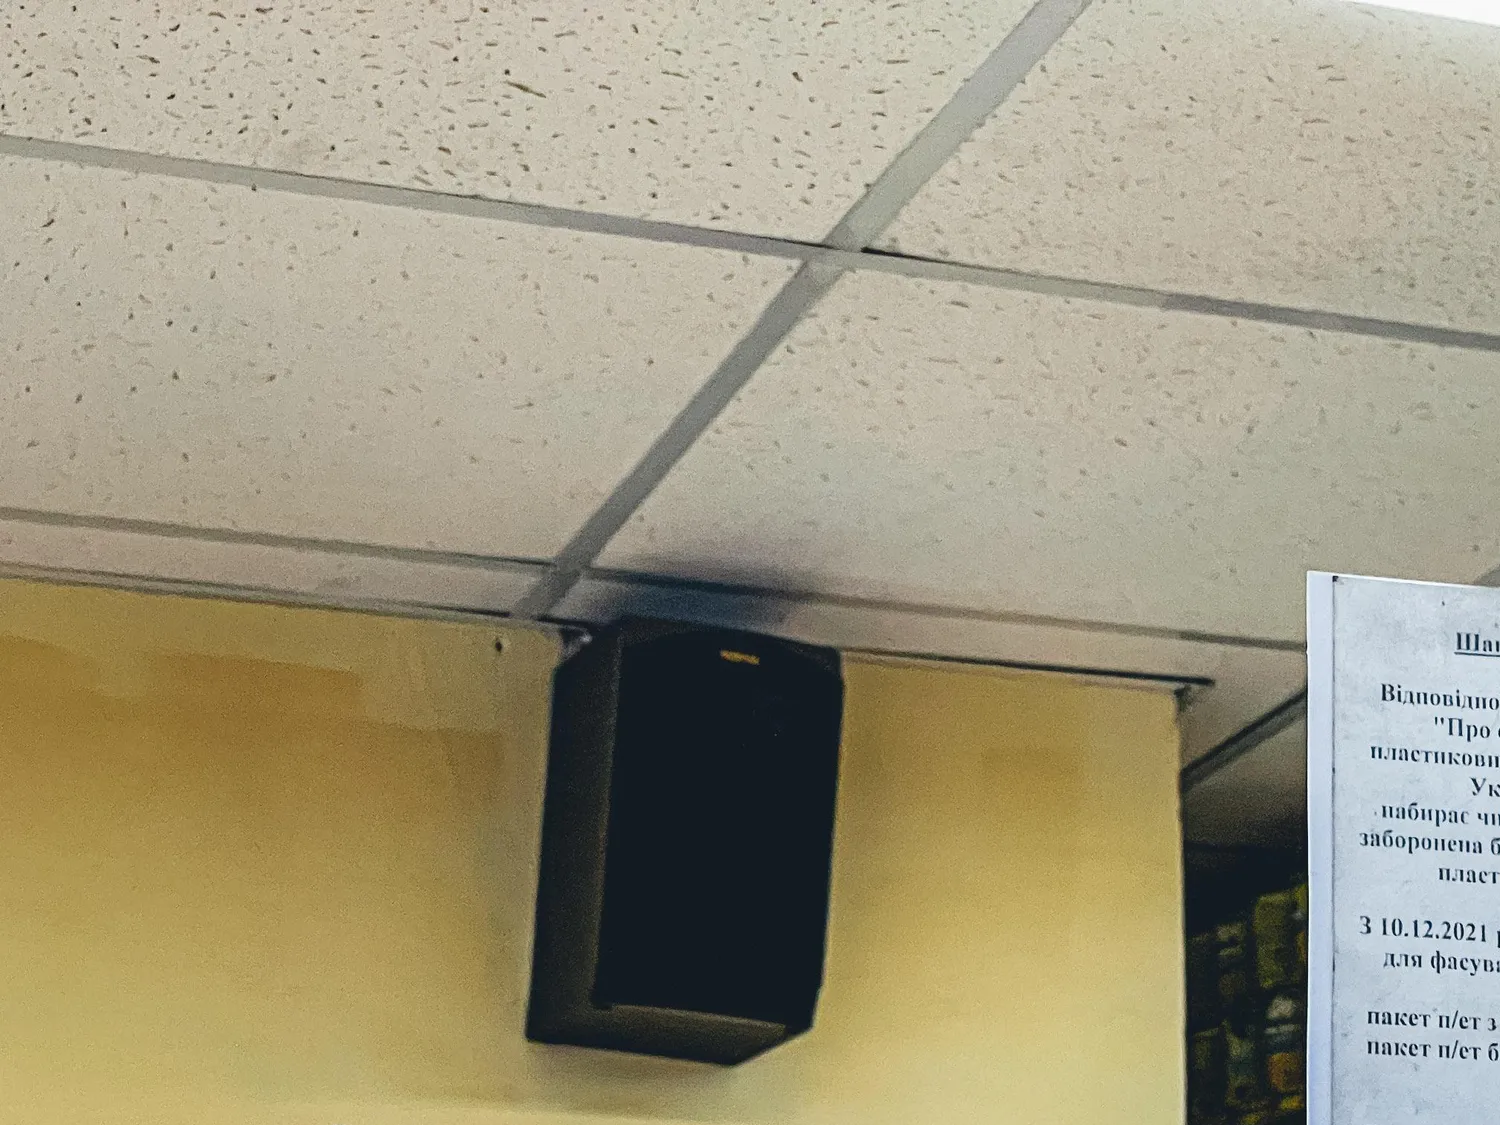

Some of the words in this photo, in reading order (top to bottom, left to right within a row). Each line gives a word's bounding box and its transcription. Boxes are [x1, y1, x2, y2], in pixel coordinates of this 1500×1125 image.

[1381, 683, 1500, 710] Відповідно
[1359, 830, 1483, 854] заборонена
[1381, 917, 1487, 942] 10.12.2021
[1383, 952, 1422, 968] для
[1367, 1010, 1431, 1027] пакет
[1487, 1017, 1497, 1031] з
[1367, 1040, 1431, 1057] пакет
